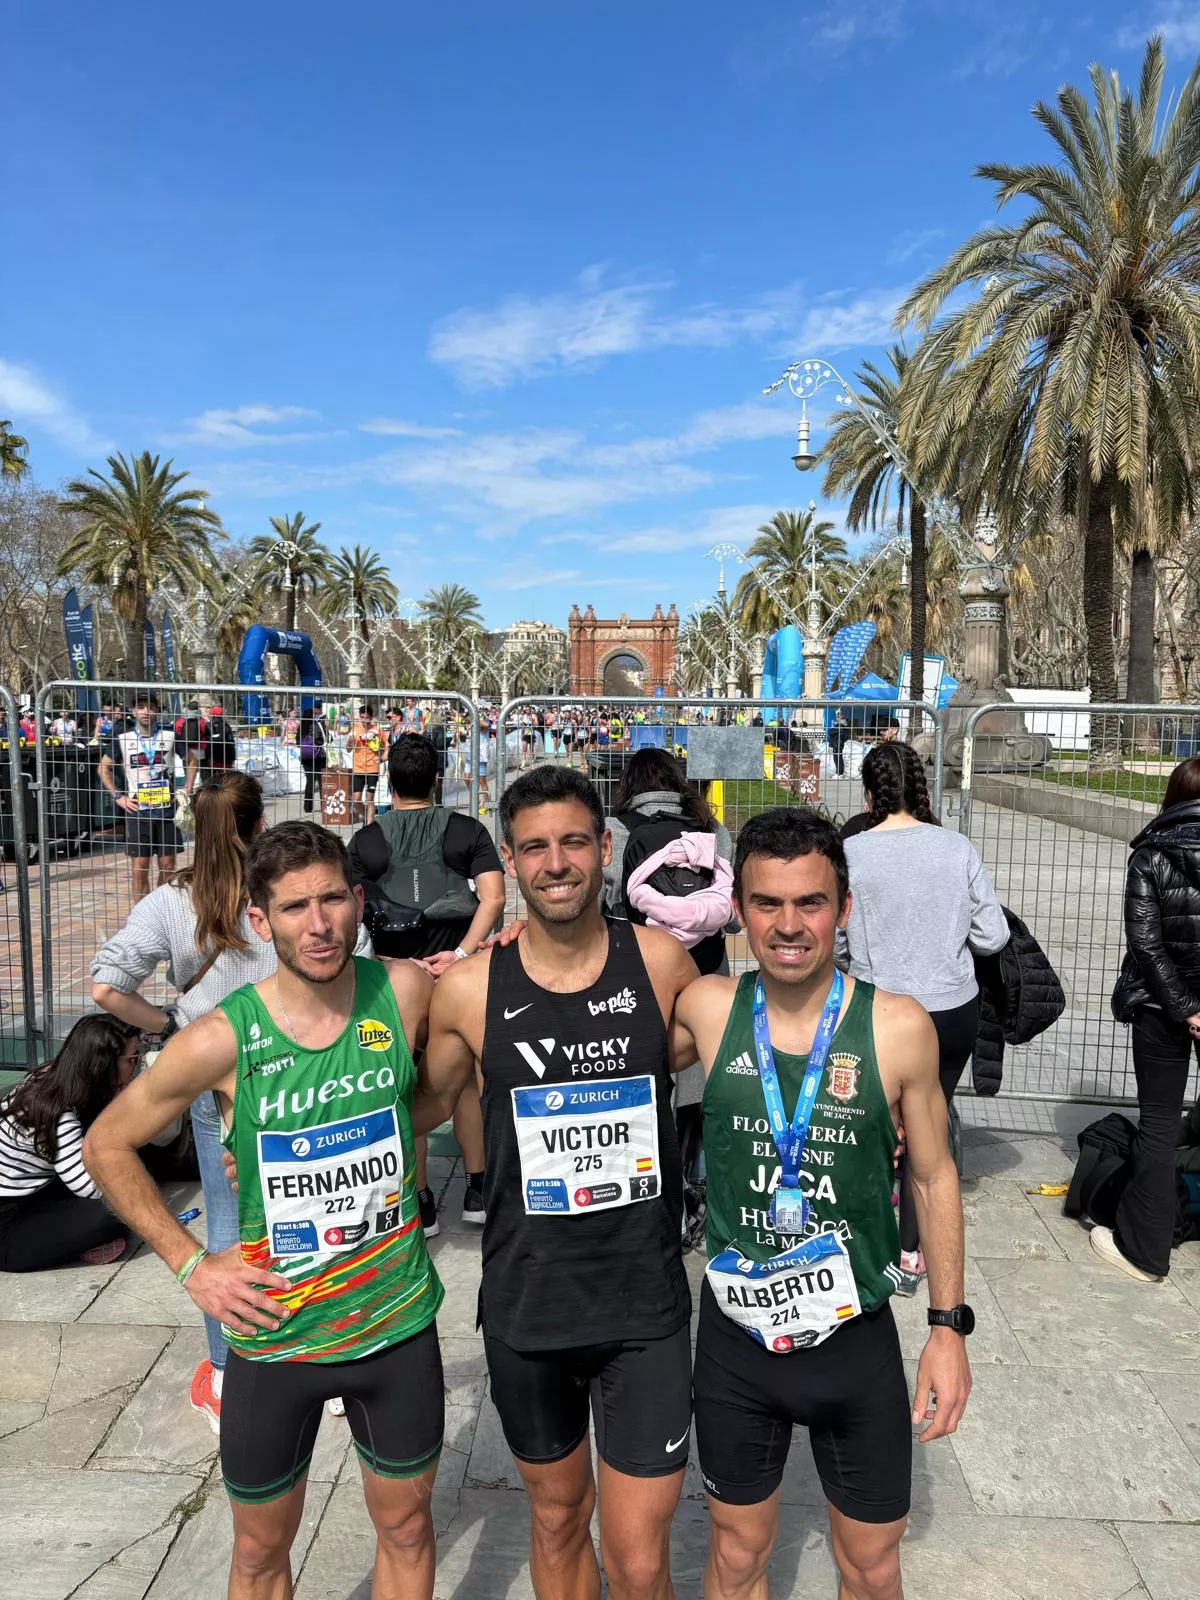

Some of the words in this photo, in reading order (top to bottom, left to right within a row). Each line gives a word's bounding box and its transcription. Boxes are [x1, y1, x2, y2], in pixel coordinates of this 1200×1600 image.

[261, 1050, 293, 1065] ATLETISMO
[562, 1037, 630, 1061] VICKY
[262, 1056, 295, 1076] ZOITI
[571, 1058, 626, 1076] FOODS
[726, 1065, 758, 1076] adidas
[258, 1067, 395, 1126] Huesca
[570, 1090, 619, 1104] ZURICH
[823, 1110, 833, 1118] DE
[834, 1112, 852, 1120] JACA
[316, 1126, 366, 1149] ZURICH
[541, 1121, 629, 1154] VICTOR
[752, 1141, 776, 1158] EL
[573, 1154, 603, 1173] 275
[267, 1151, 398, 1200] FERNANDO
[324, 1195, 356, 1215] 272
[755, 1231, 777, 1247] La
[759, 1255, 809, 1271] ZURICH
[727, 1267, 834, 1309] ALBERTO
[771, 1305, 801, 1327] 274
